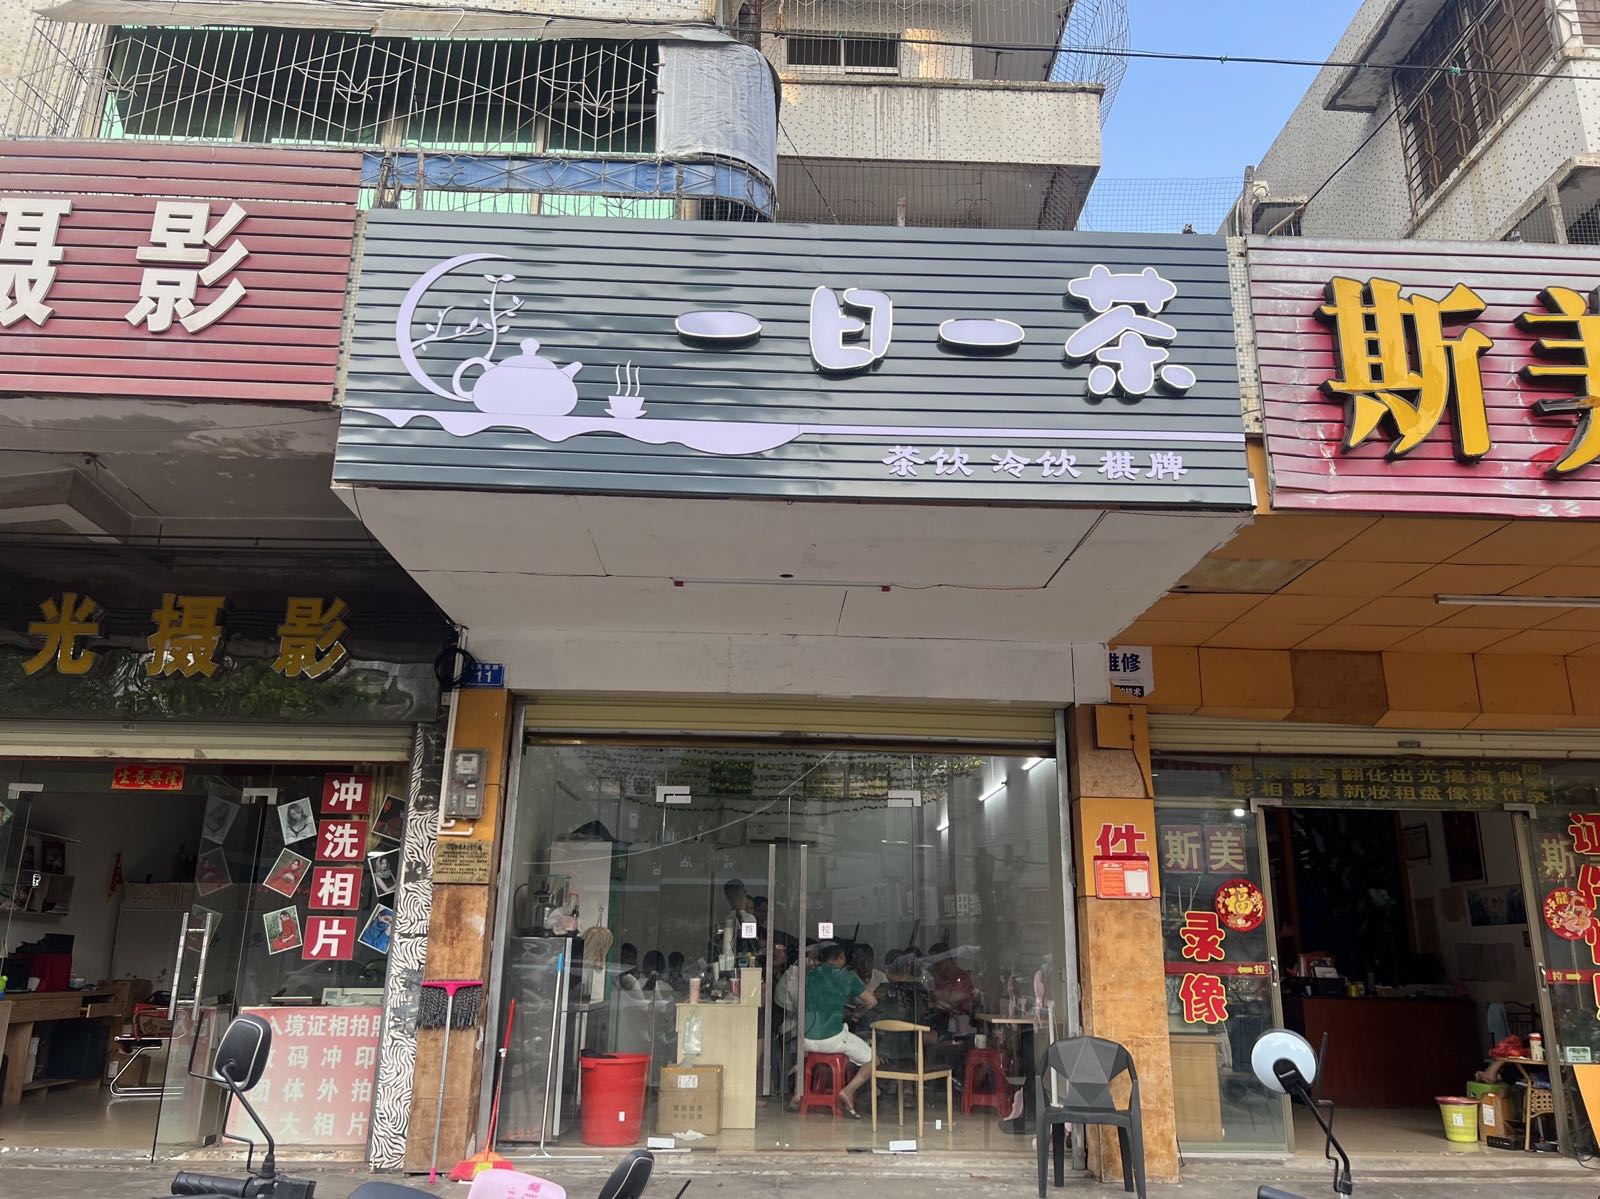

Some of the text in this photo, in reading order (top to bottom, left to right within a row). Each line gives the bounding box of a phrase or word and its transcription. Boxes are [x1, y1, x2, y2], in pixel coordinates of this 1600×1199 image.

[675, 264, 1197, 396] 一日一茶
[882, 445, 1188, 481] 茶饮 冷饮 棋牌
[21, 591, 351, 680] 光摄影
[475, 671, 491, 683] 11
[310, 776, 363, 957] 冲洗相片
[1164, 831, 1245, 870] 斯美
[1180, 911, 1228, 1024] 录像
